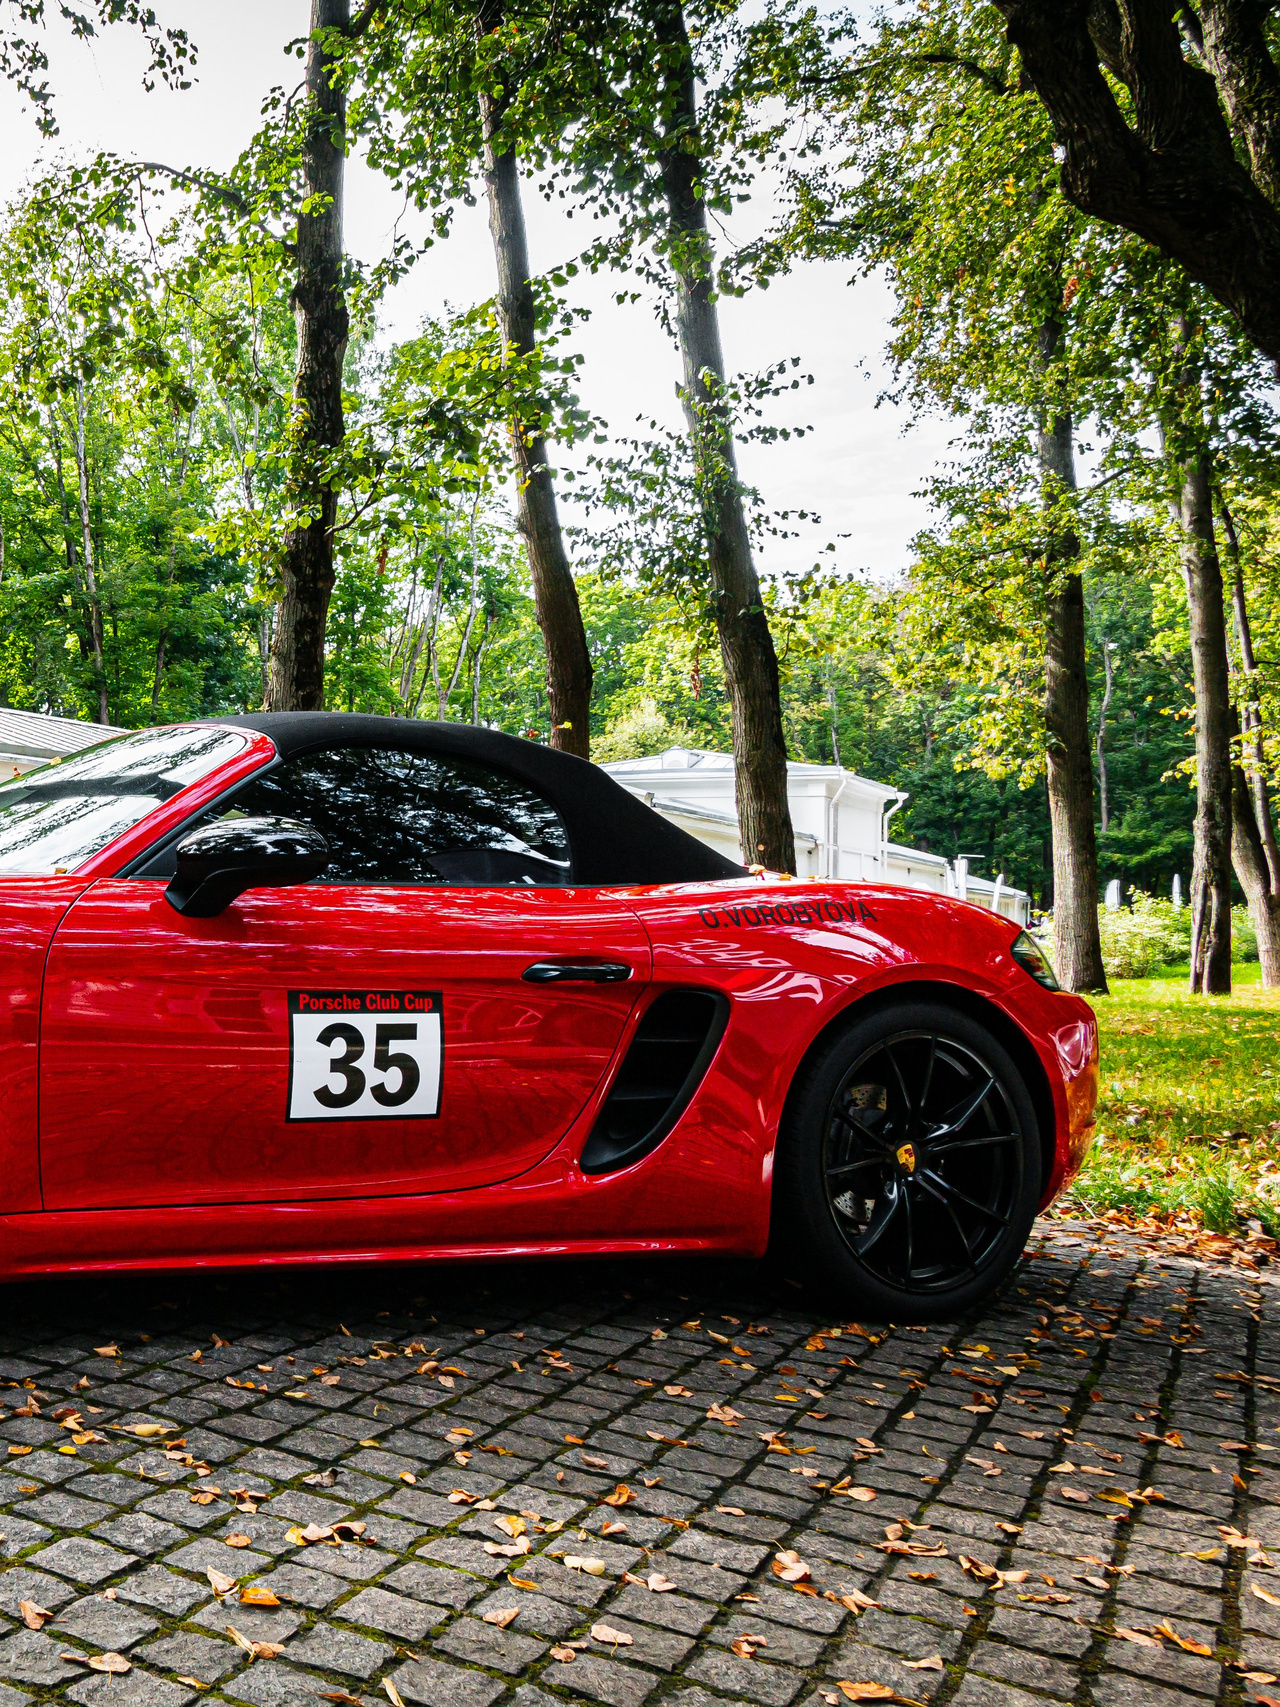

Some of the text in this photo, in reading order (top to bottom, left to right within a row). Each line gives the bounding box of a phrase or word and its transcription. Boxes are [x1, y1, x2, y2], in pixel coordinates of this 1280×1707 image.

[699, 901, 878, 929] O.VOROBYOVA
[299, 993, 433, 1012] Porsche Club Cup
[313, 1022, 420, 1109] 35
